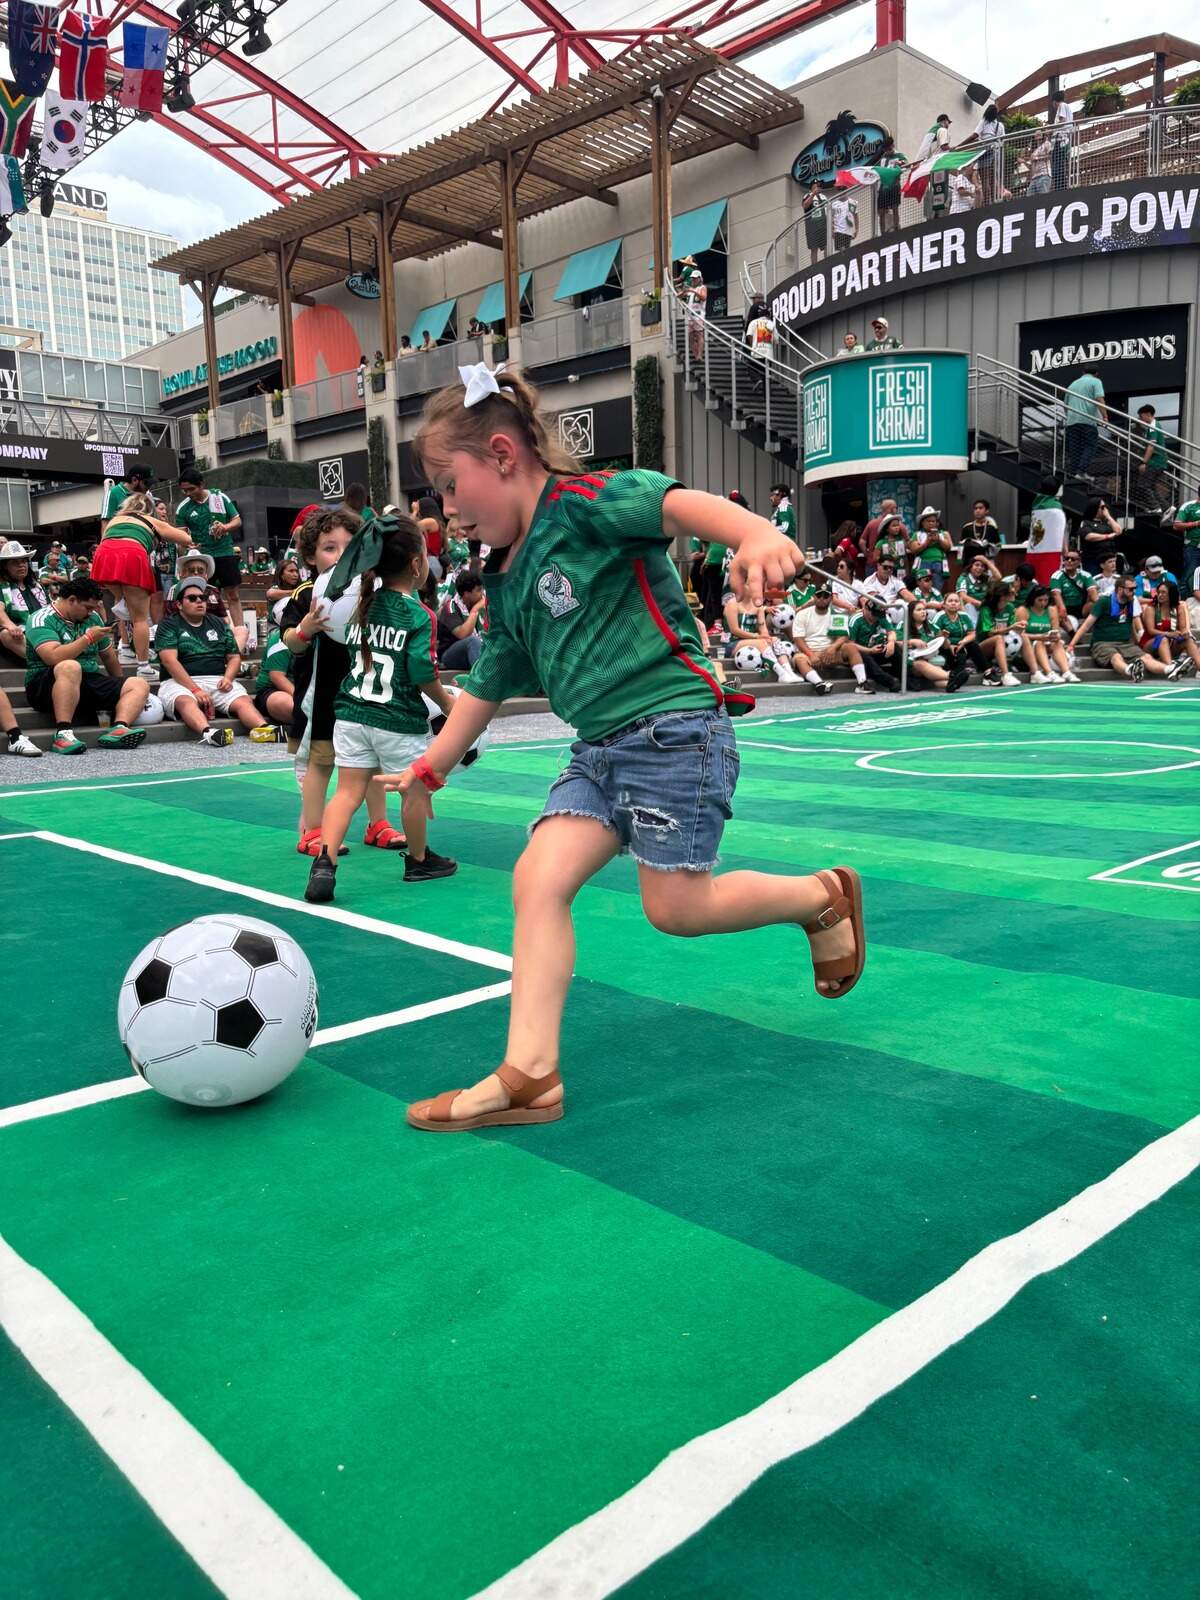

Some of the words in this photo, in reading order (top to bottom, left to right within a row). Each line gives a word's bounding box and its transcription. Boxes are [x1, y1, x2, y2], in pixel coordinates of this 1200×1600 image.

[772, 273, 826, 324] PROUD
[832, 227, 966, 301] PARTNER
[976, 212, 1025, 259] OF
[1035, 201, 1089, 248] KC
[1101, 188, 1199, 238] POW
[1030, 334, 1176, 375] McFADDEN'S
[804, 383, 827, 421] FRESH
[876, 370, 925, 407] FRESH
[804, 417, 827, 455] KARMA
[876, 406, 925, 442] KARMA
[0, 444, 48, 460] MPANY
[84, 443, 117, 453] UPCOMING
[118, 446, 139, 455] EVENTS
